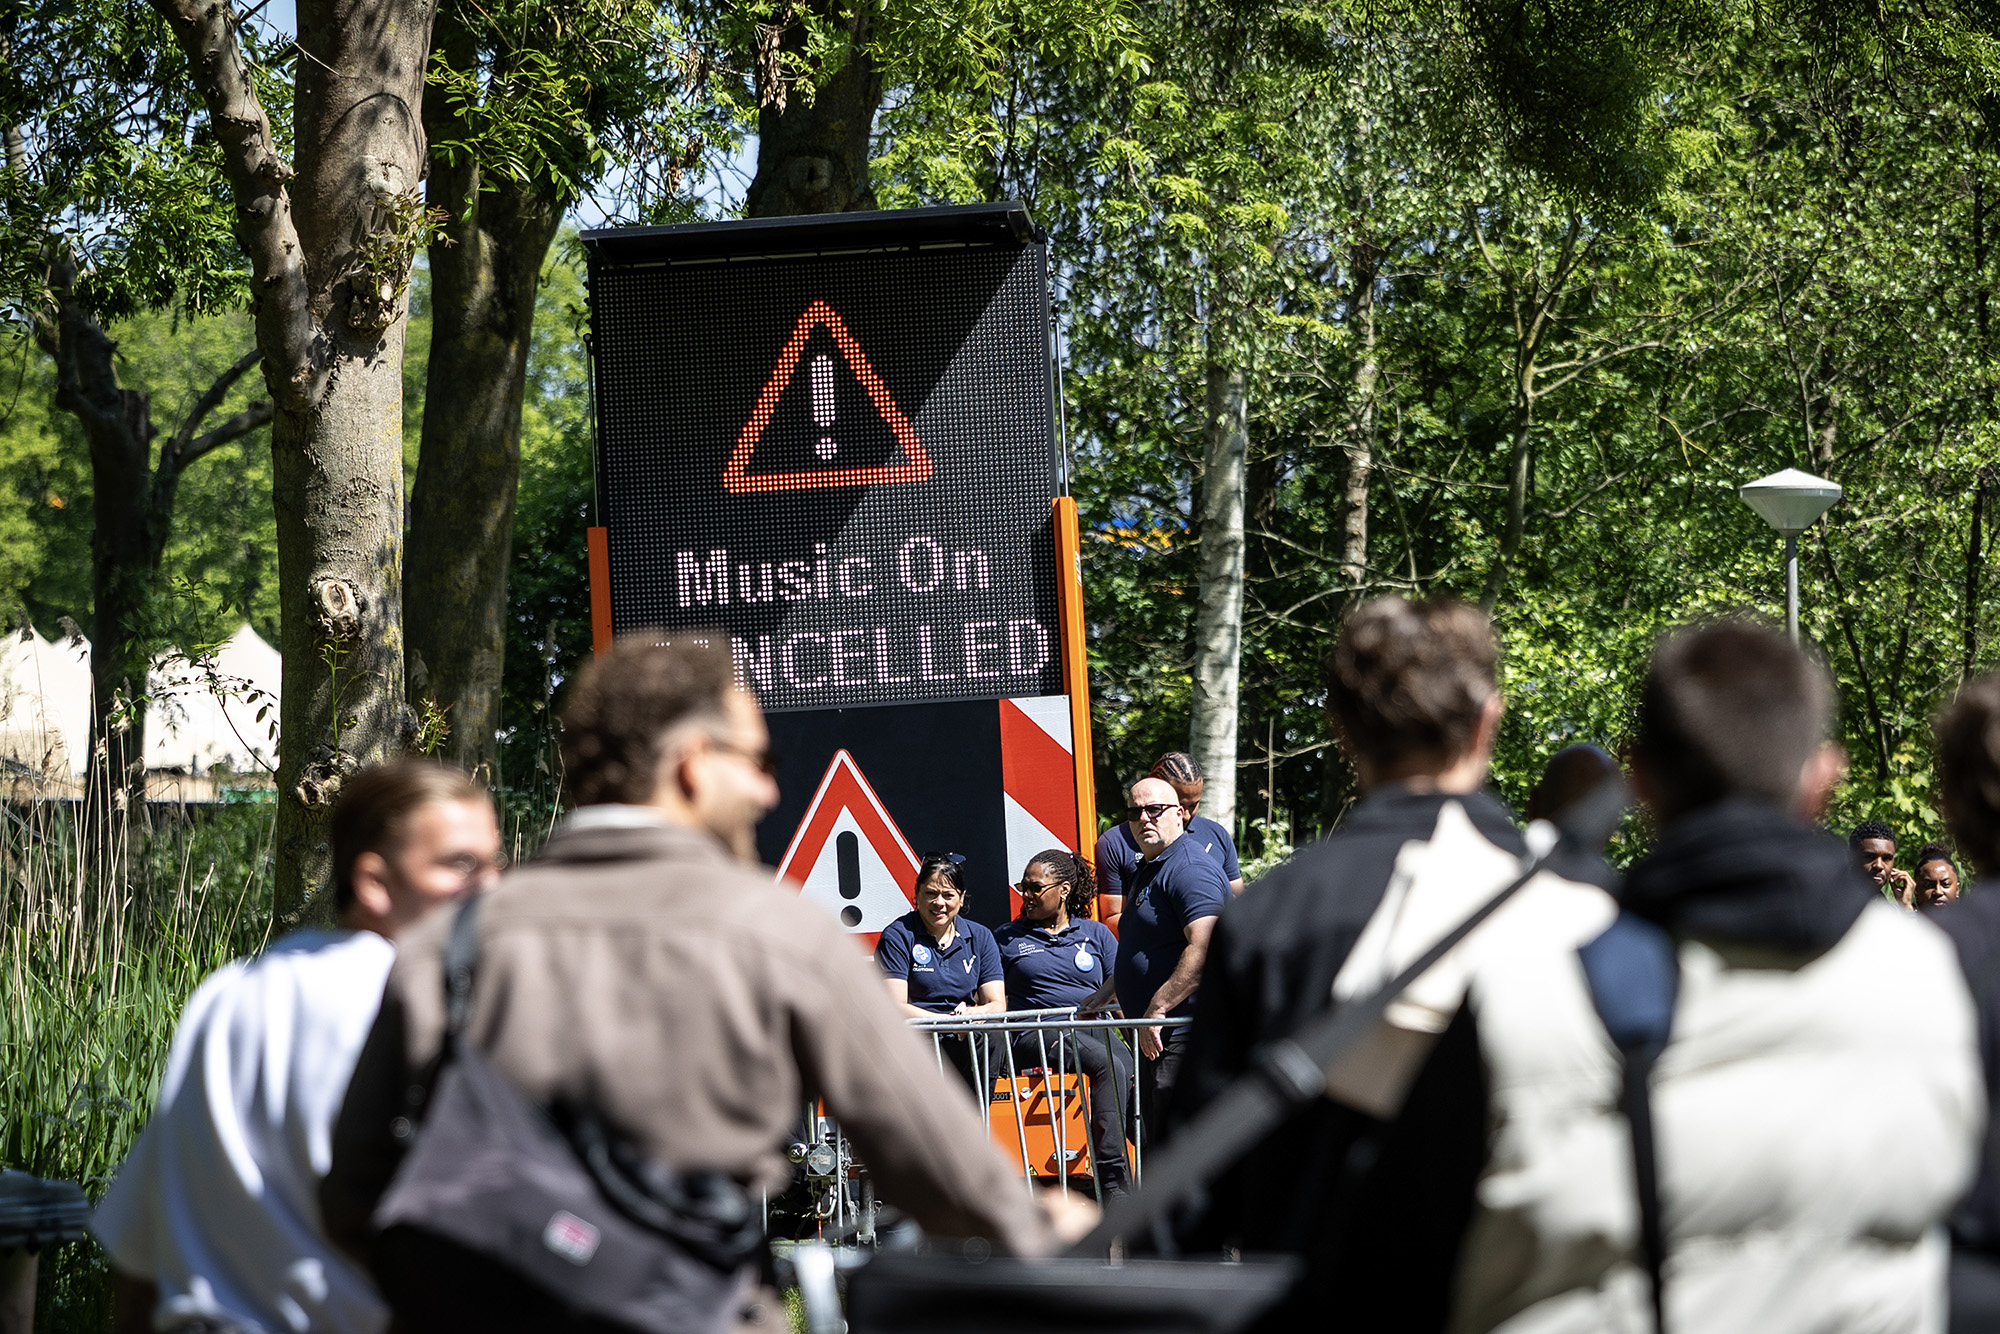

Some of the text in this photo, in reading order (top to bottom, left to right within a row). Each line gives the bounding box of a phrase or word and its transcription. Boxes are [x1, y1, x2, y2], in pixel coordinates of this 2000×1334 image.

[676, 536, 990, 607] Music On
[644, 618, 1050, 692] NCELLED
